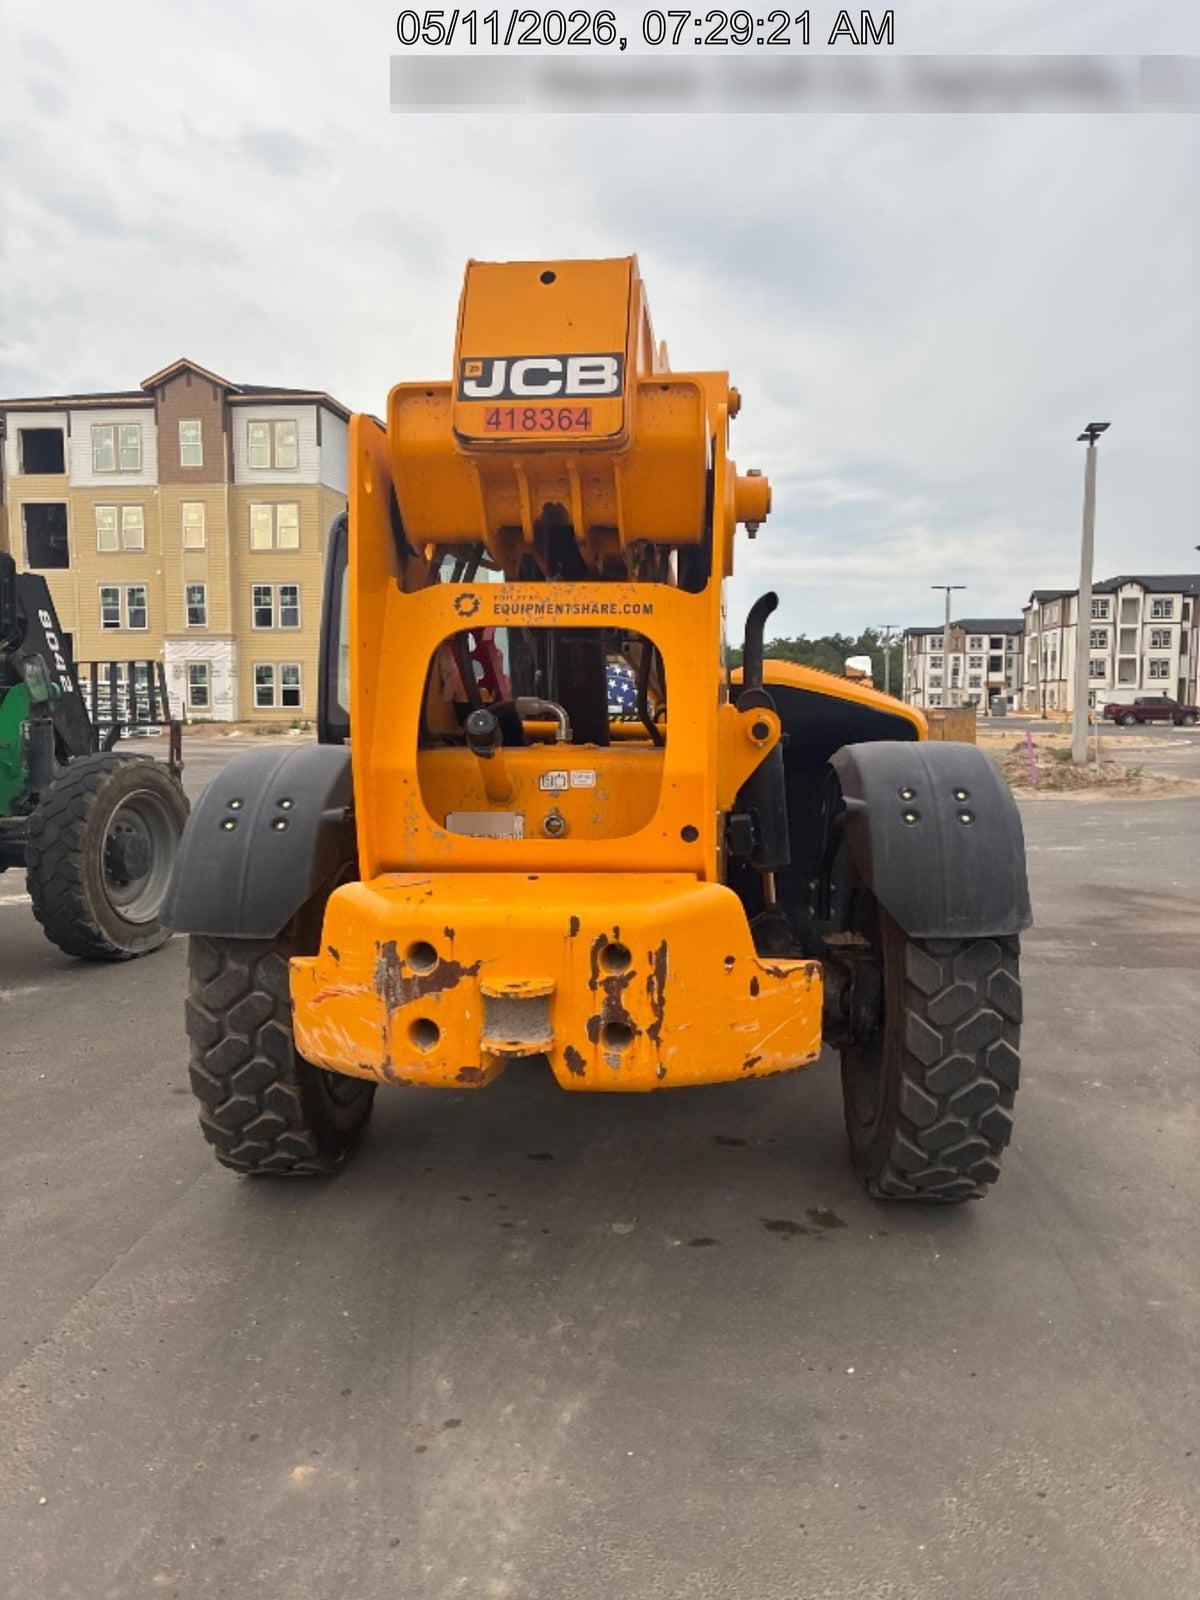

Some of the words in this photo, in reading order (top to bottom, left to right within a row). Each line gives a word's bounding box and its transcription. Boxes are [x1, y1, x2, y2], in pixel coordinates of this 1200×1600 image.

[463, 356, 619, 397] JCB
[486, 408, 591, 431] 418364
[493, 603, 654, 615] EQUIPMENTSHARE.COM
